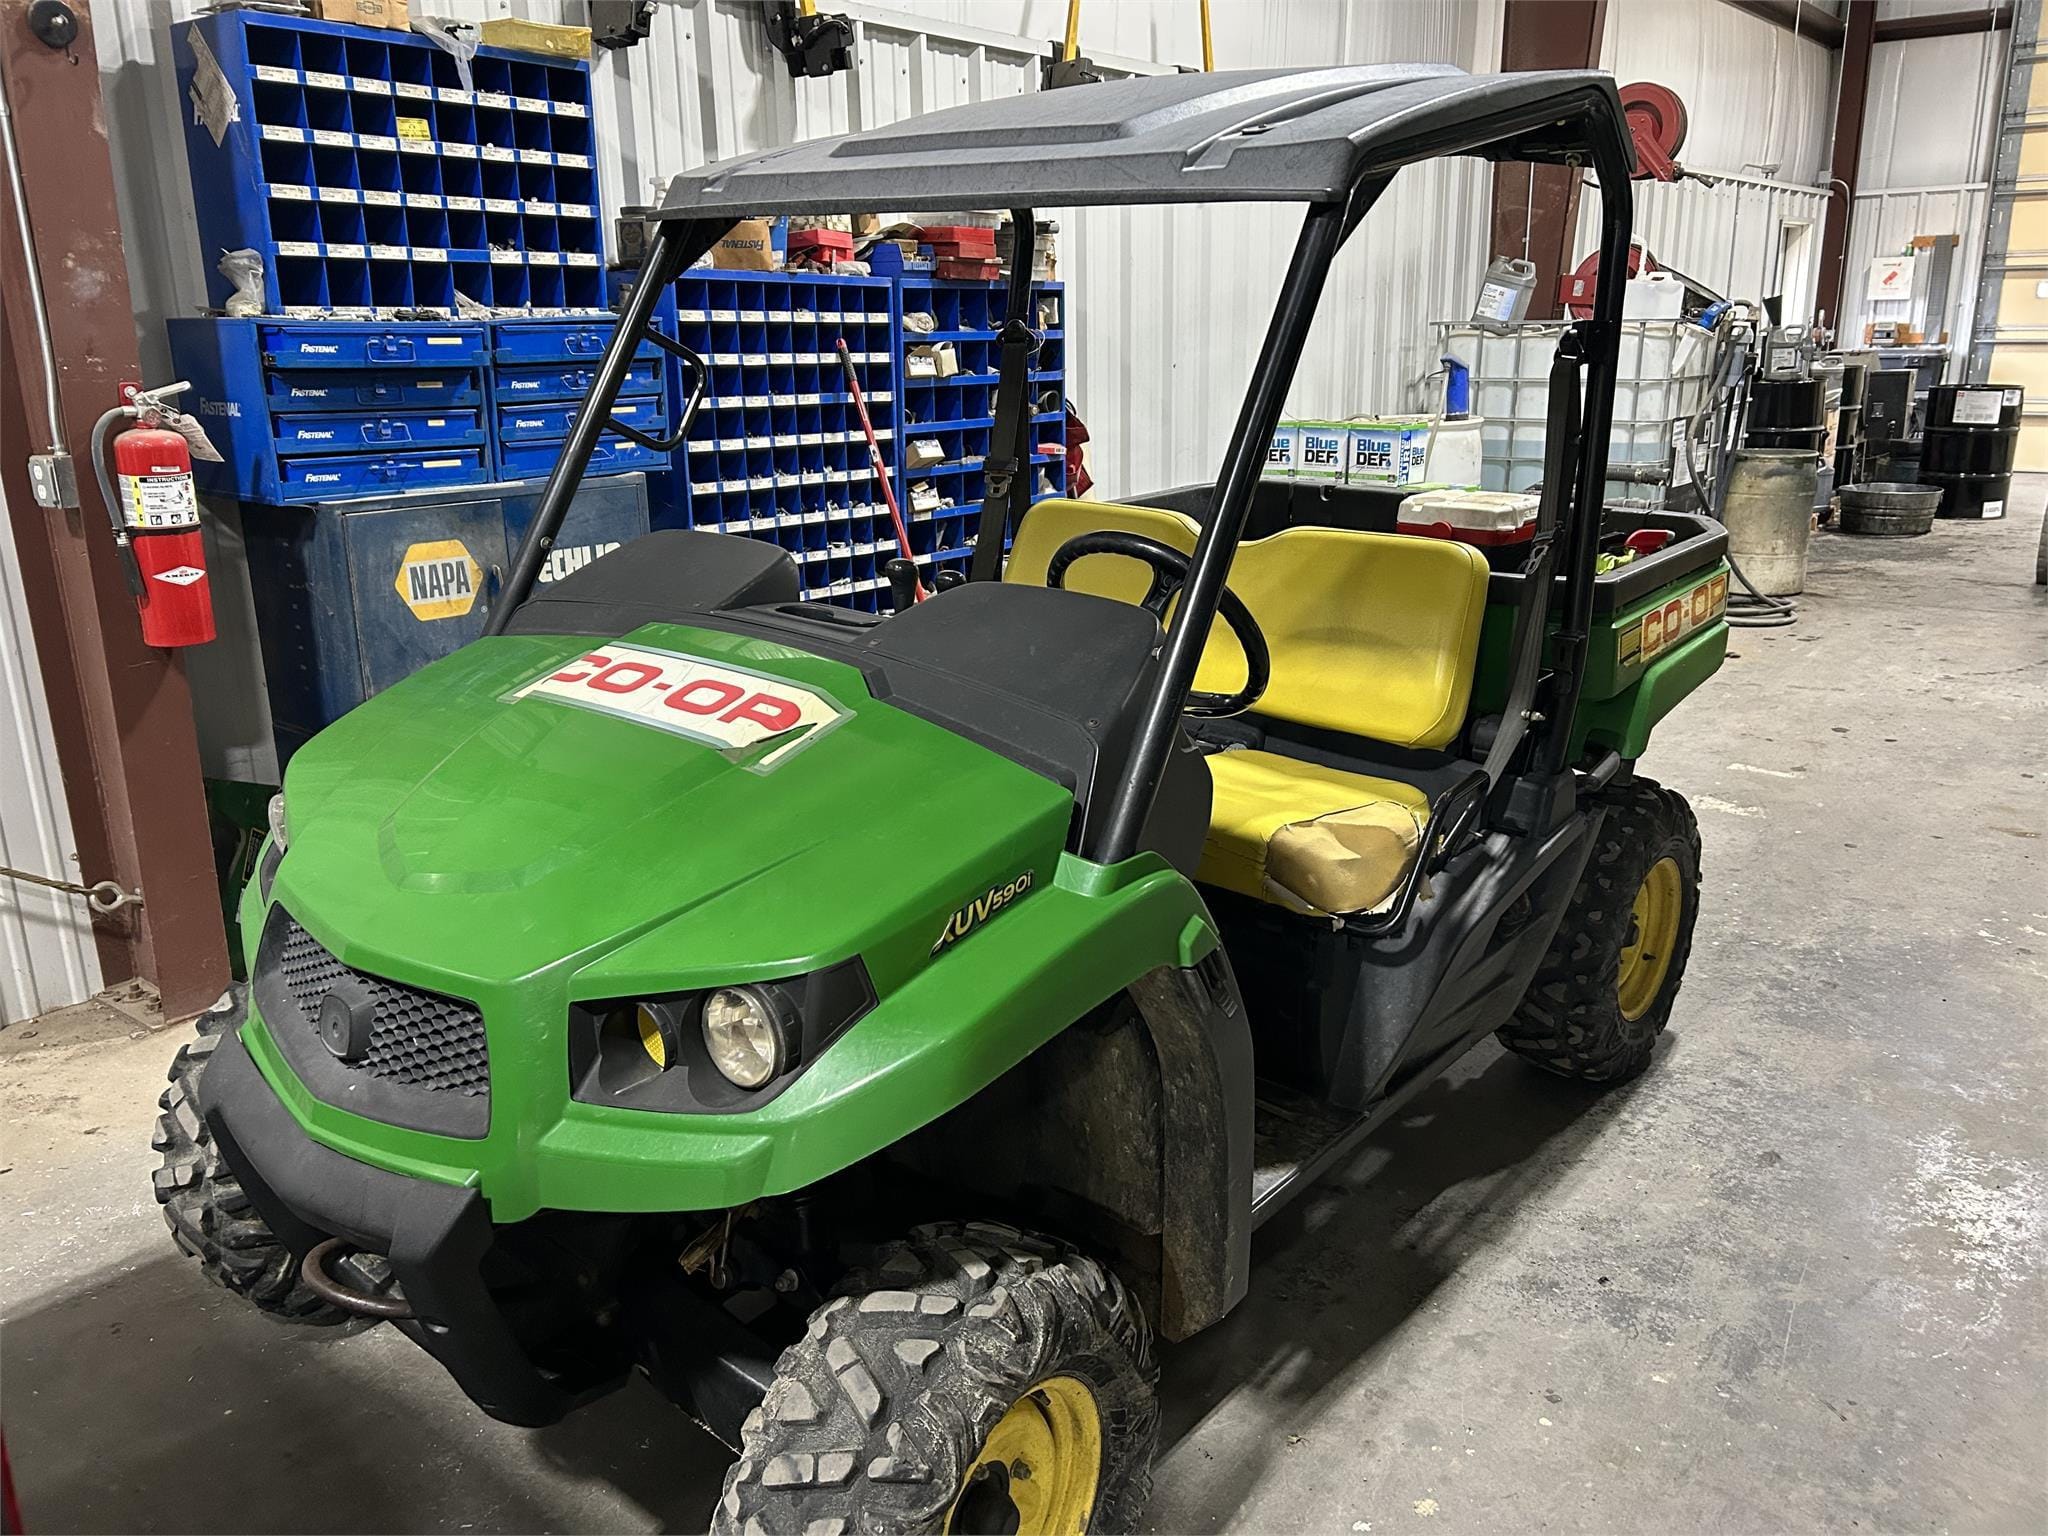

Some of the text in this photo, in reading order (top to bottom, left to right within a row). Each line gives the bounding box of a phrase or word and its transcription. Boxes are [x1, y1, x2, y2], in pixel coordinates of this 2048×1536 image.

[721, 239, 764, 251] FASTENAL
[301, 343, 338, 353] FASTENAL
[511, 380, 540, 389] FASTENAL
[291, 388, 328, 397] FASTENAL
[199, 397, 242, 417] FASTENAL
[515, 420, 545, 428] FASTENAL
[297, 430, 334, 439] FASTENAL
[1271, 438, 1290, 448] ue
[1305, 436, 1338, 450] Blue
[1357, 438, 1391, 453] Blue
[1267, 449, 1290, 462] EF
[1304, 449, 1337, 464] DEF
[1412, 447, 1425, 455] Blue
[1356, 452, 1388, 467] DEF
[1411, 455, 1424, 466] DEF
[305, 473, 341, 482] FASTENAL
[409, 561, 471, 601] NAPA
[1643, 575, 1726, 656] CO-OP
[549, 654, 802, 732] CO-OP
